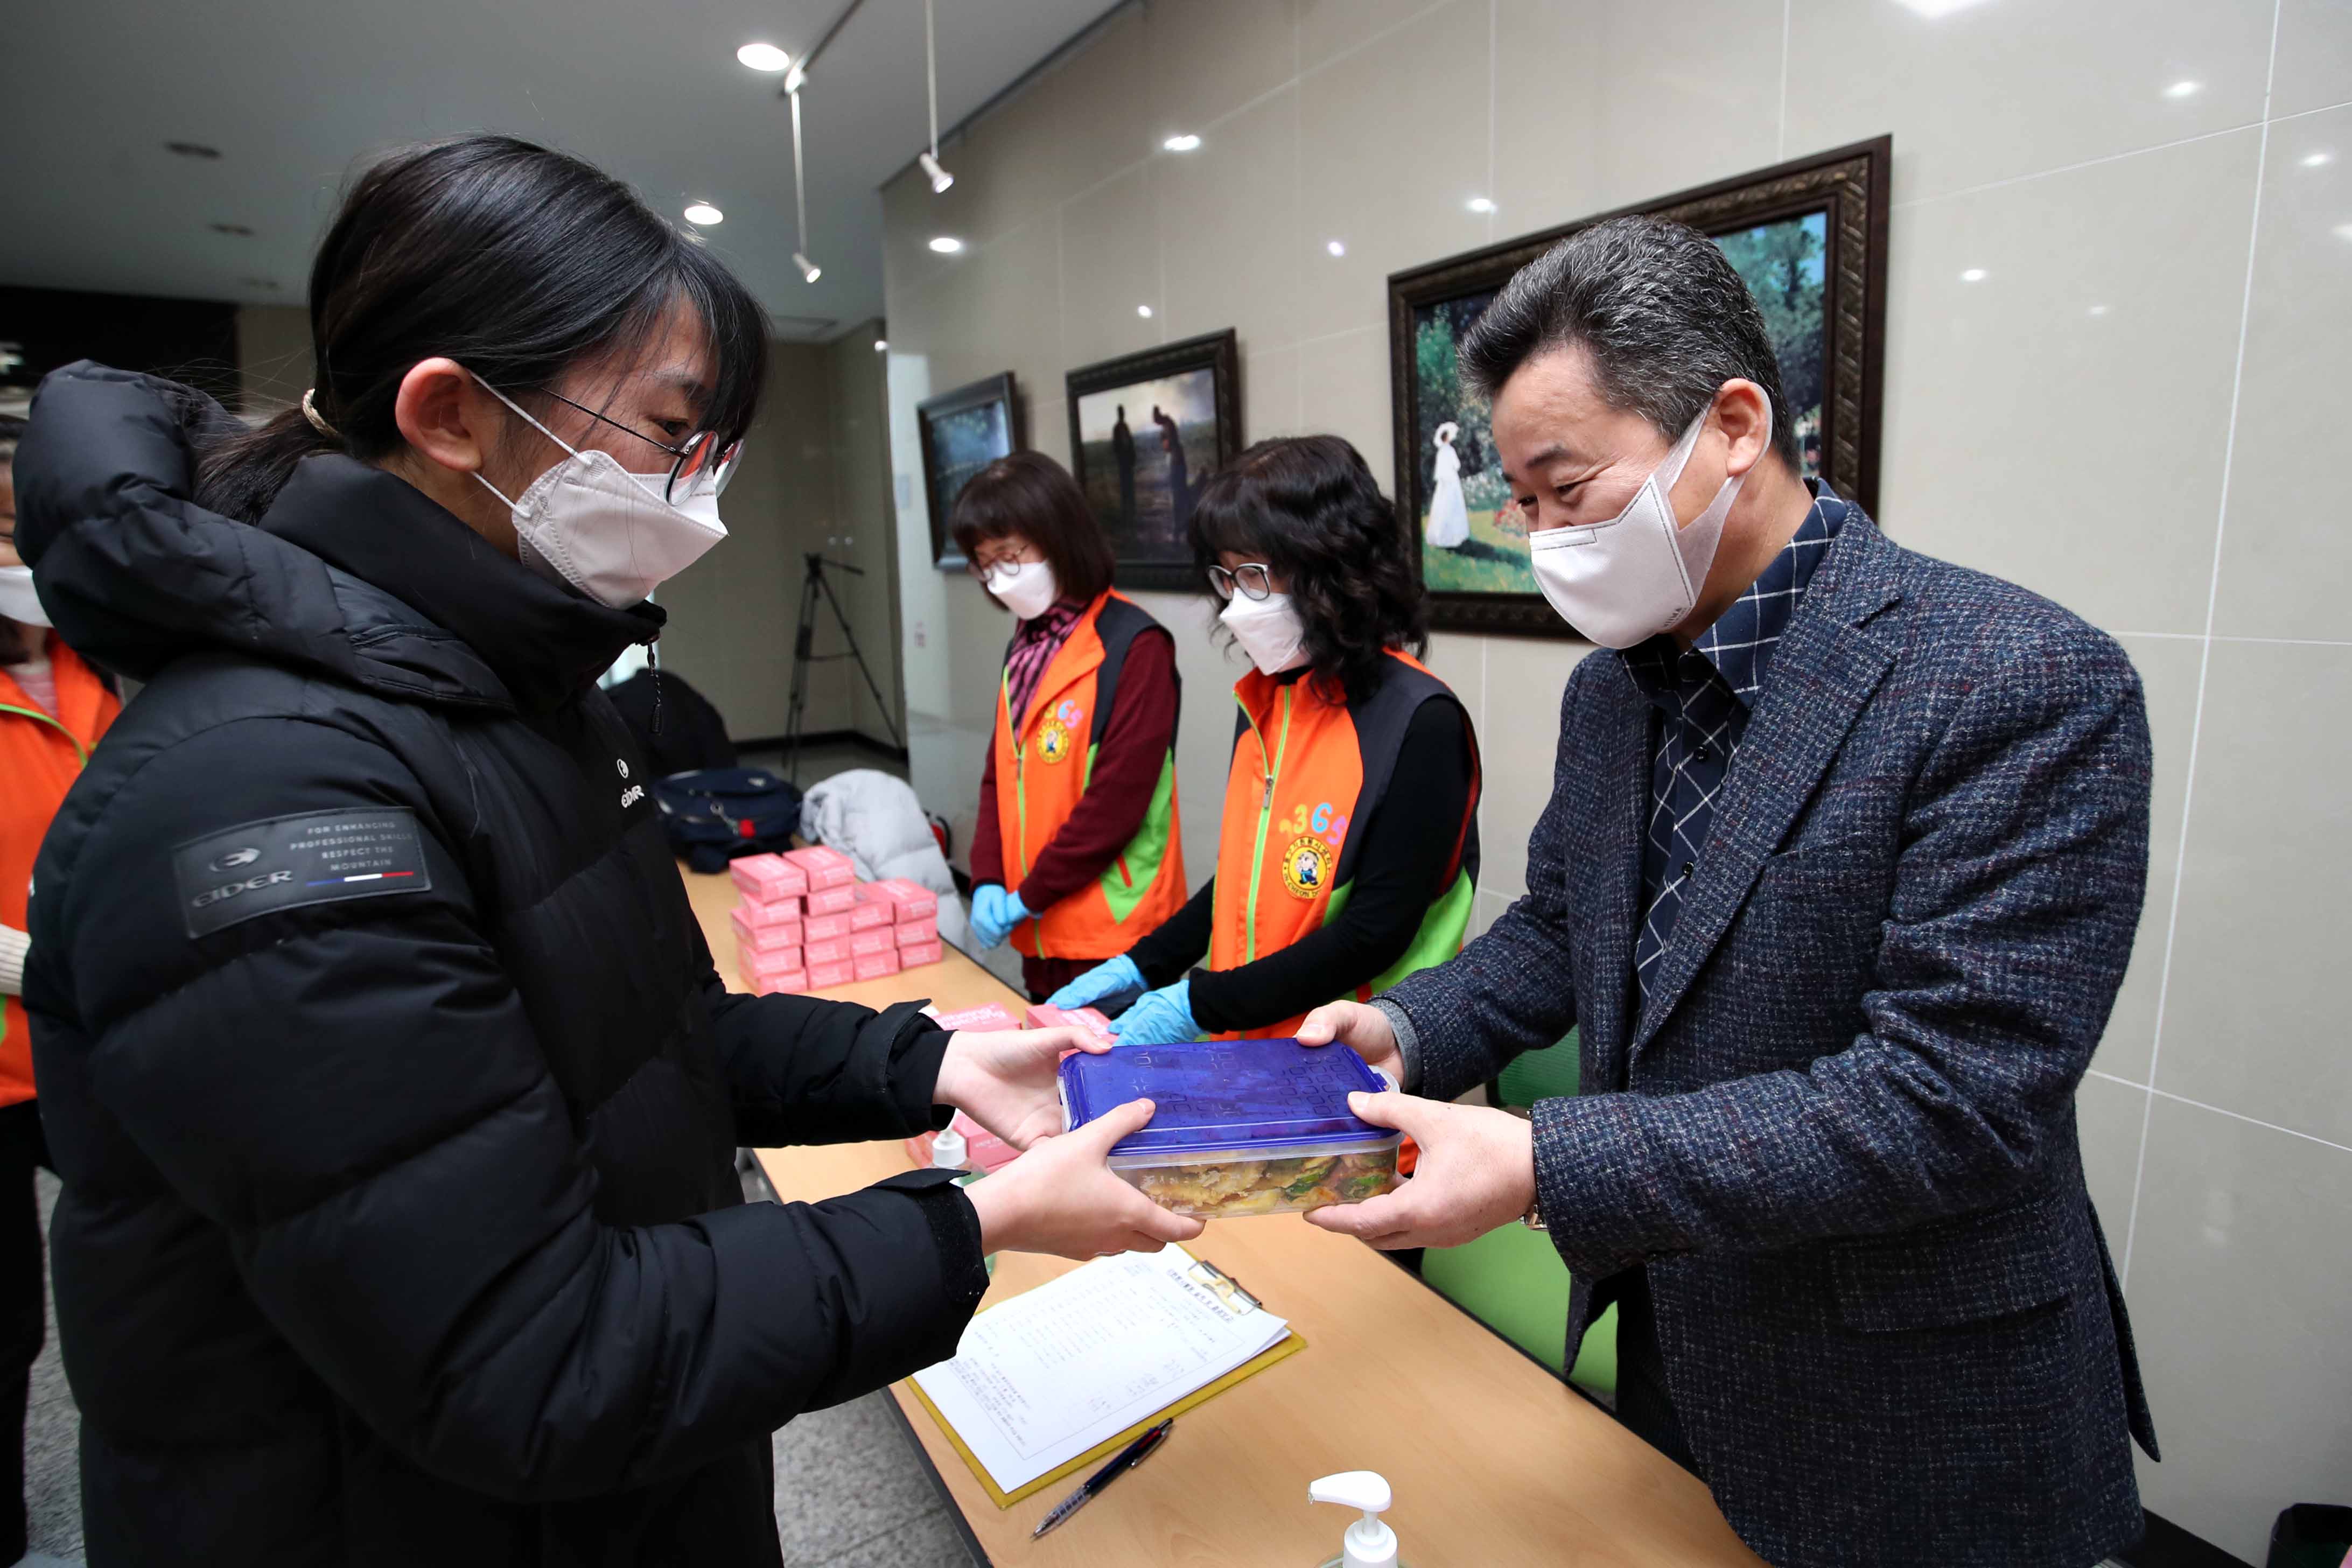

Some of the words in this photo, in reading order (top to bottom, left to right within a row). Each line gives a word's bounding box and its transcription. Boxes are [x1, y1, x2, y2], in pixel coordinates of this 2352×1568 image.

[307, 826, 331, 835] FOR
[334, 822, 396, 832] ENHANCING
[1293, 802, 1347, 845] 365
[290, 834, 376, 850] PROFESSIONAL
[321, 847, 370, 859] RESPECT
[330, 859, 392, 871] MOUNTAIN
